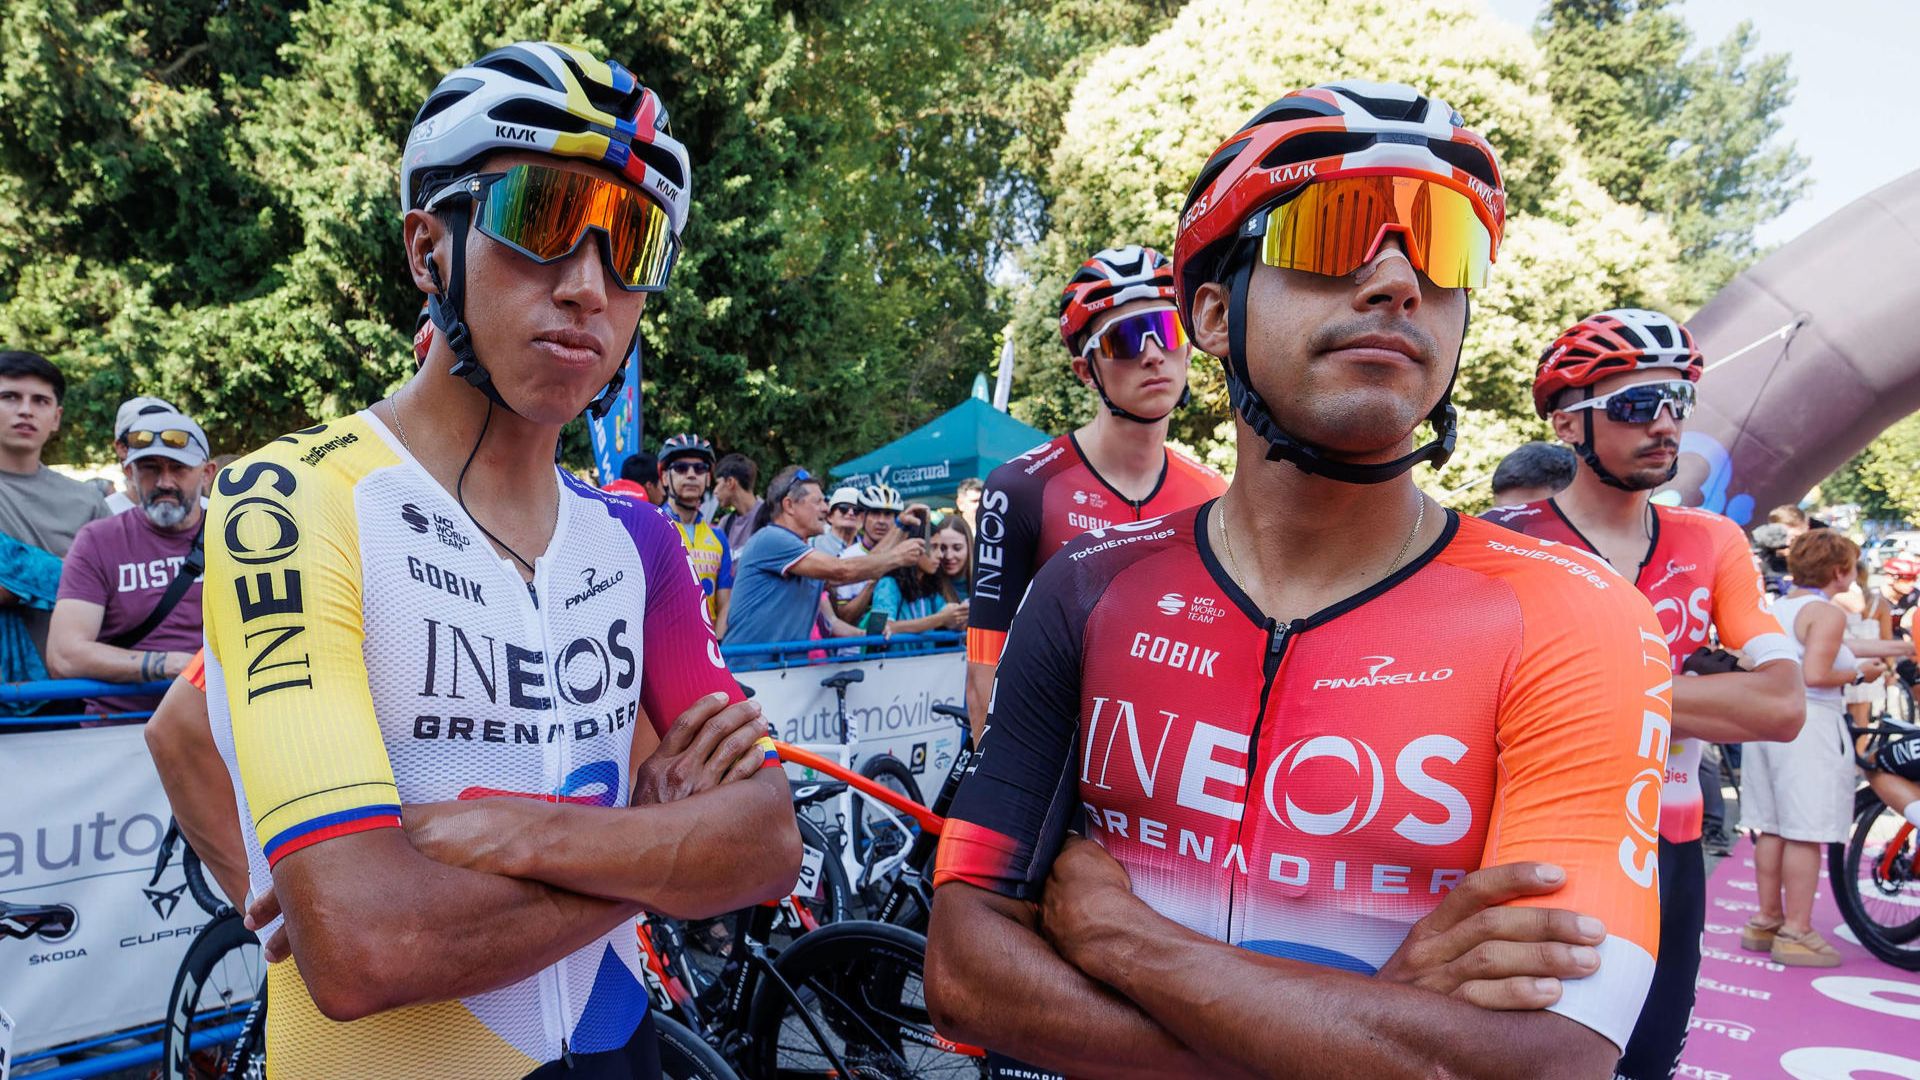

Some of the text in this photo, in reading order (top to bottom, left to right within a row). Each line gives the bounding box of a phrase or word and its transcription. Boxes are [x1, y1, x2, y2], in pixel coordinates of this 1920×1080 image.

[496, 125, 536, 143] KASK
[1269, 163, 1316, 184] KASK
[656, 178, 678, 202] KASK
[1468, 177, 1494, 204] KASK
[433, 513, 454, 530] UCI
[434, 522, 470, 546] WORLD
[437, 532, 464, 552] TEAM
[975, 489, 1008, 601] INEOS
[118, 556, 204, 593] DIST
[1487, 540, 1610, 590] TotalEnergies
[217, 462, 312, 705] INEOS
[407, 555, 486, 606] GOBIK
[564, 570, 624, 609] PINARELLO
[1191, 604, 1226, 618] WORLD
[1193, 596, 1216, 606] UCI
[1187, 612, 1215, 624] TEAM
[418, 618, 636, 711] INEOS
[1130, 632, 1221, 678] GOBIK
[1312, 667, 1453, 691] PINARELLO
[1892, 739, 1920, 765] INE
[951, 749, 972, 782] INEOS
[1080, 697, 1473, 846] INEOS
[0, 812, 179, 878] auto
[29, 948, 88, 966] ŠKODA
[899, 1027, 956, 1052] PINARELLO
